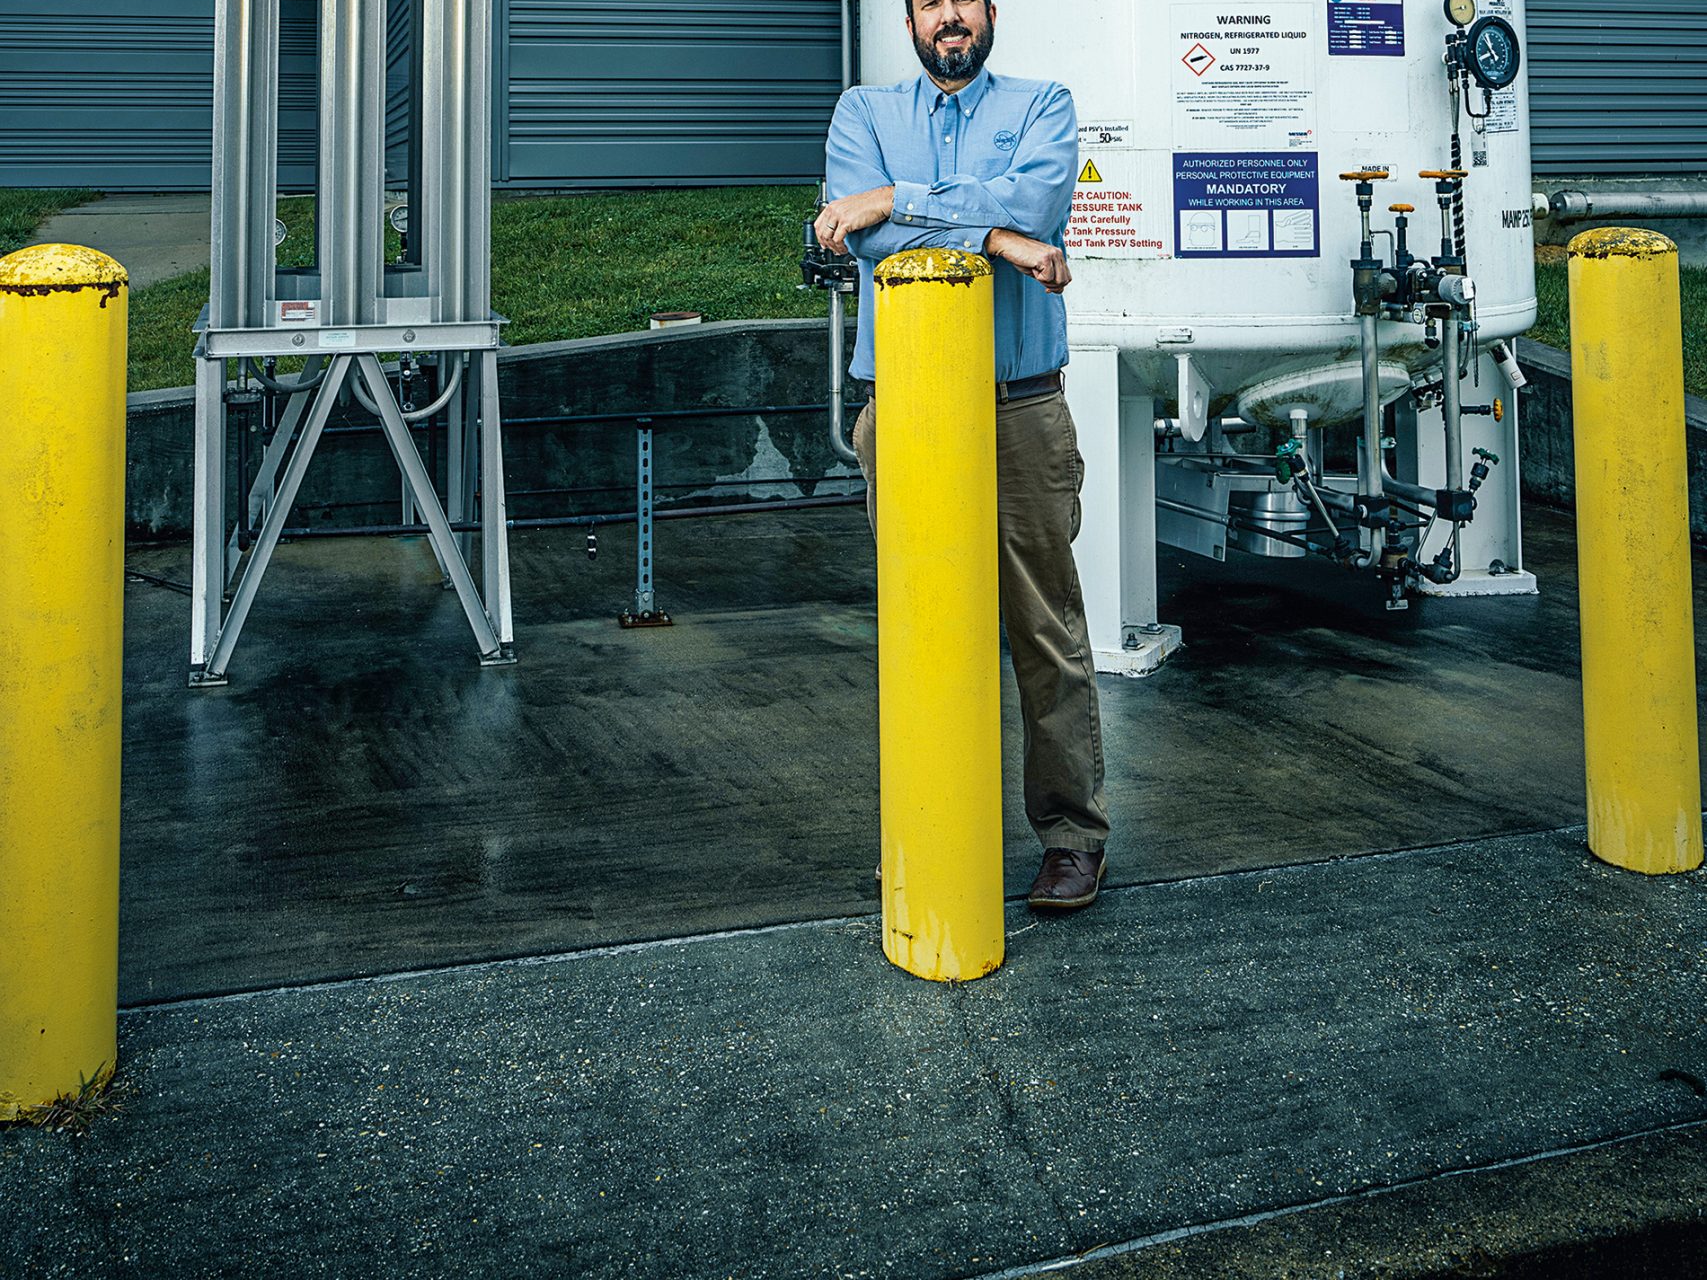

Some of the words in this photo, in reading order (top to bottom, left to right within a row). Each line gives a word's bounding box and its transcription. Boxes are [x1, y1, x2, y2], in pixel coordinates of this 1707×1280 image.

[1216, 15, 1271, 25] WARNING
[1180, 32, 1223, 40] NITROGEN,
[1224, 31, 1280, 39] REFRIGERATED
[1281, 31, 1307, 39] LIQUID
[1230, 47, 1241, 55] UN
[1242, 47, 1260, 55] 1977
[1183, 160, 1236, 168] AUTHORIZED
[1237, 159, 1286, 167] PERSONNEL
[1286, 159, 1308, 167] ONLY
[1219, 171, 1269, 179] PROTECTIVE
[1270, 170, 1315, 179] EQUIPMENT
[1206, 183, 1287, 194] MANDATORY
[1072, 191, 1084, 200] ER
[1086, 191, 1132, 200] CAUTION:
[1188, 198, 1214, 207] WHILE
[1215, 198, 1254, 206] WORKING
[1255, 198, 1263, 206] IN
[1264, 198, 1282, 206] THIS
[1071, 203, 1114, 212] RESSURE
[1116, 203, 1143, 211] TANK
[1090, 215, 1131, 225] Carefully
[1072, 227, 1093, 235] Tank
[1095, 227, 1136, 235] Pressure
[1064, 239, 1082, 248] sted
[1085, 239, 1106, 247] Tank
[1108, 239, 1127, 247] PSV
[1129, 239, 1163, 249] Setting
